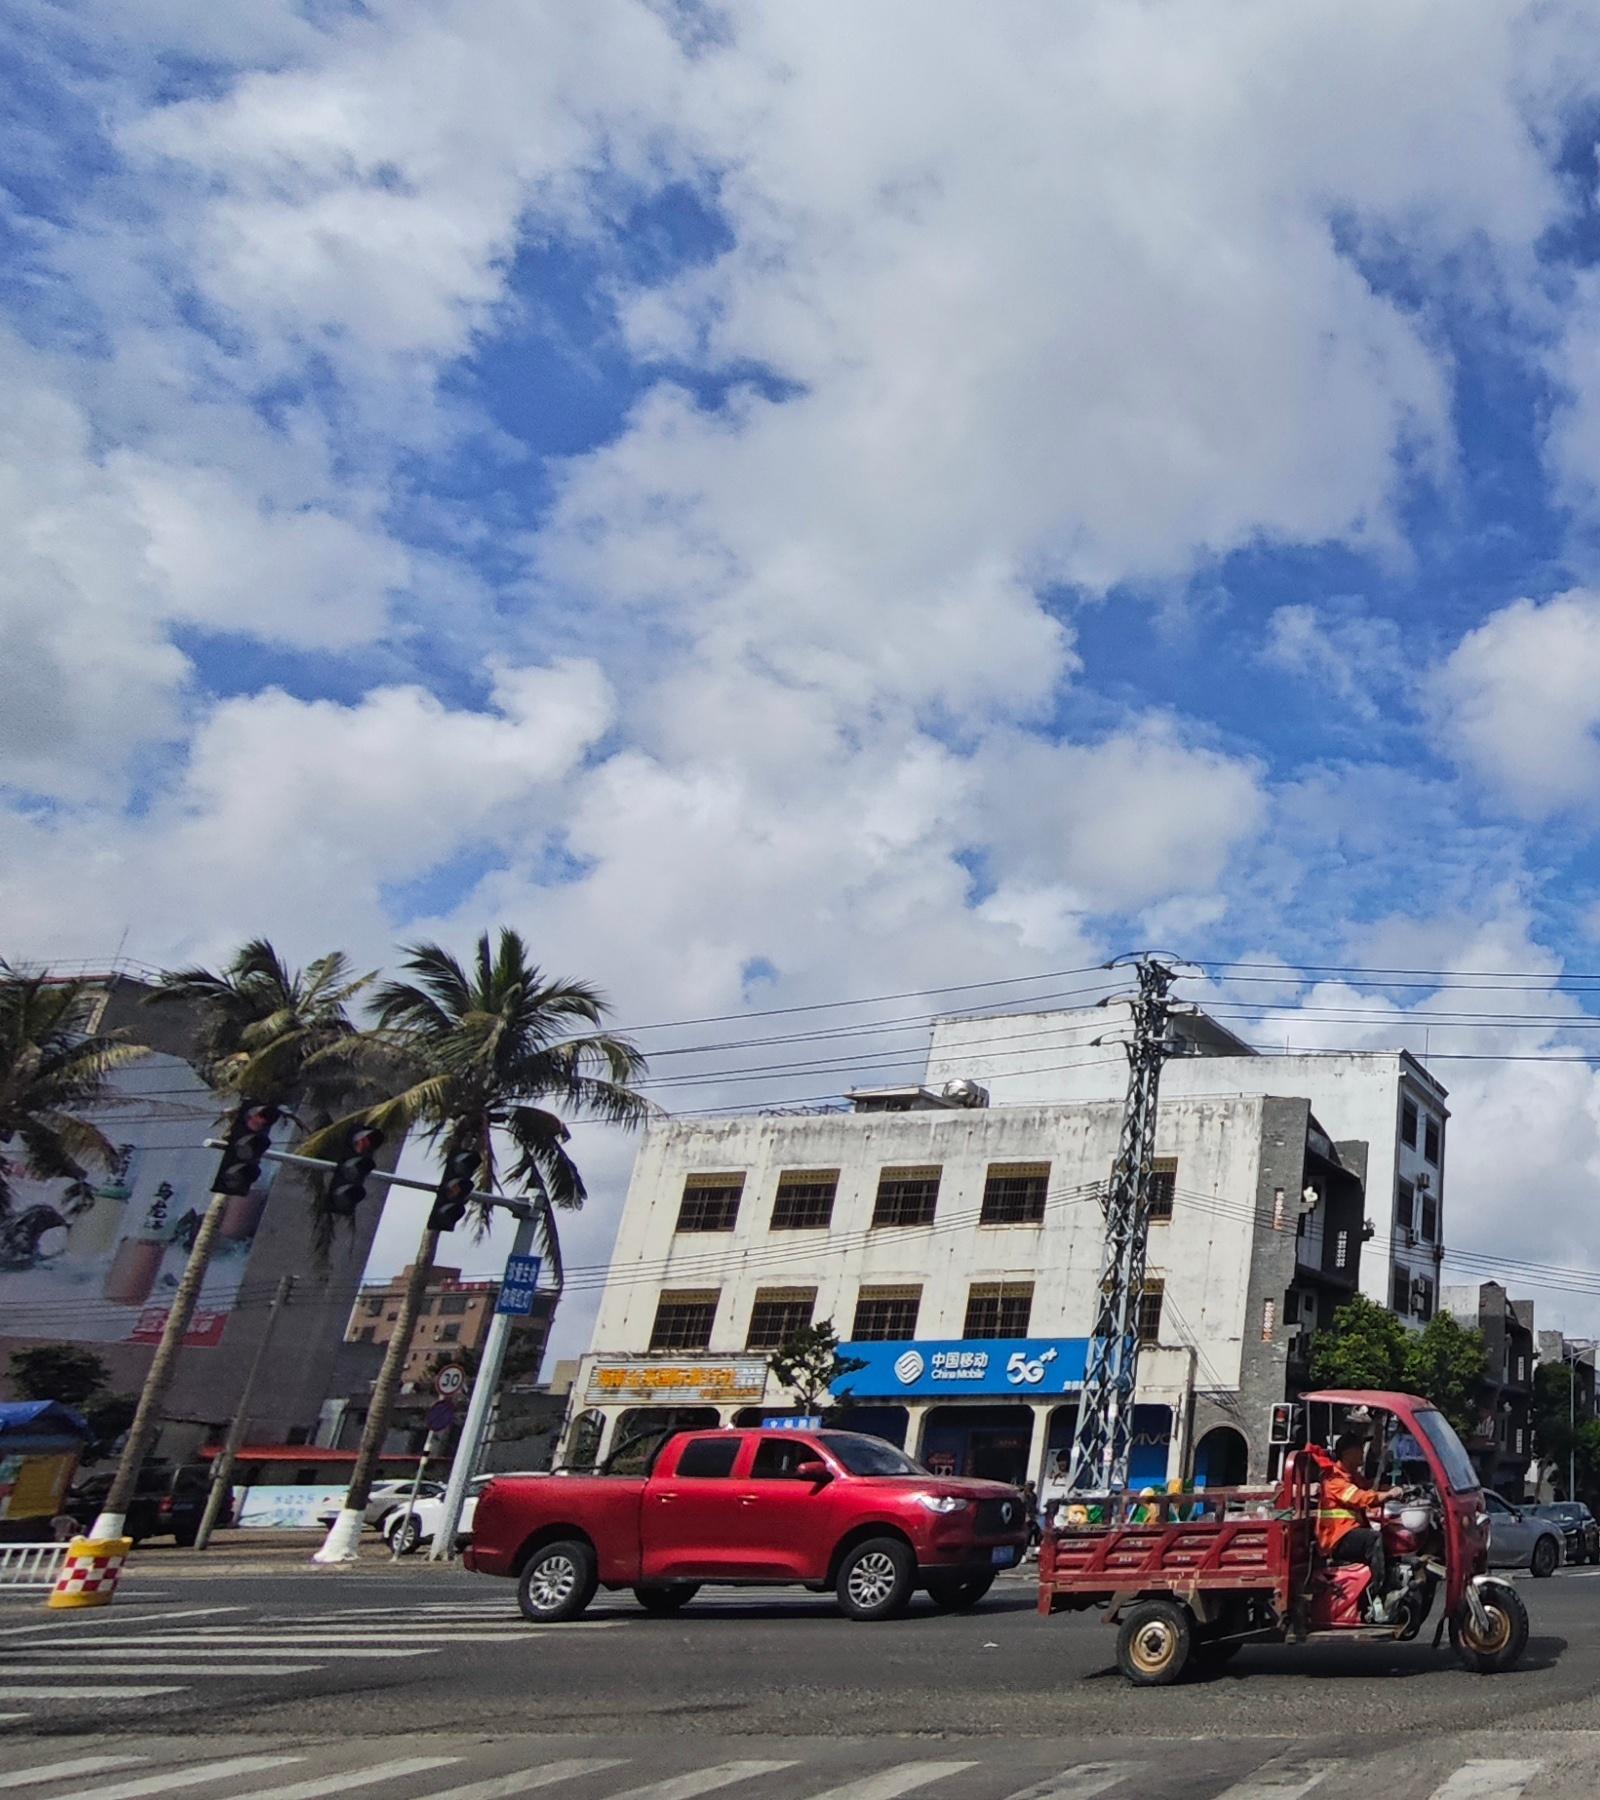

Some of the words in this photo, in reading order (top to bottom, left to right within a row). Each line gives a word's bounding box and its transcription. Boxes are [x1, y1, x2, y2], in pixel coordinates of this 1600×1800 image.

[931, 1352, 989, 1369] 中国移动
[441, 1373, 461, 1387] 30
[931, 1369, 957, 1380] China
[957, 1368, 986, 1380] Mobile
